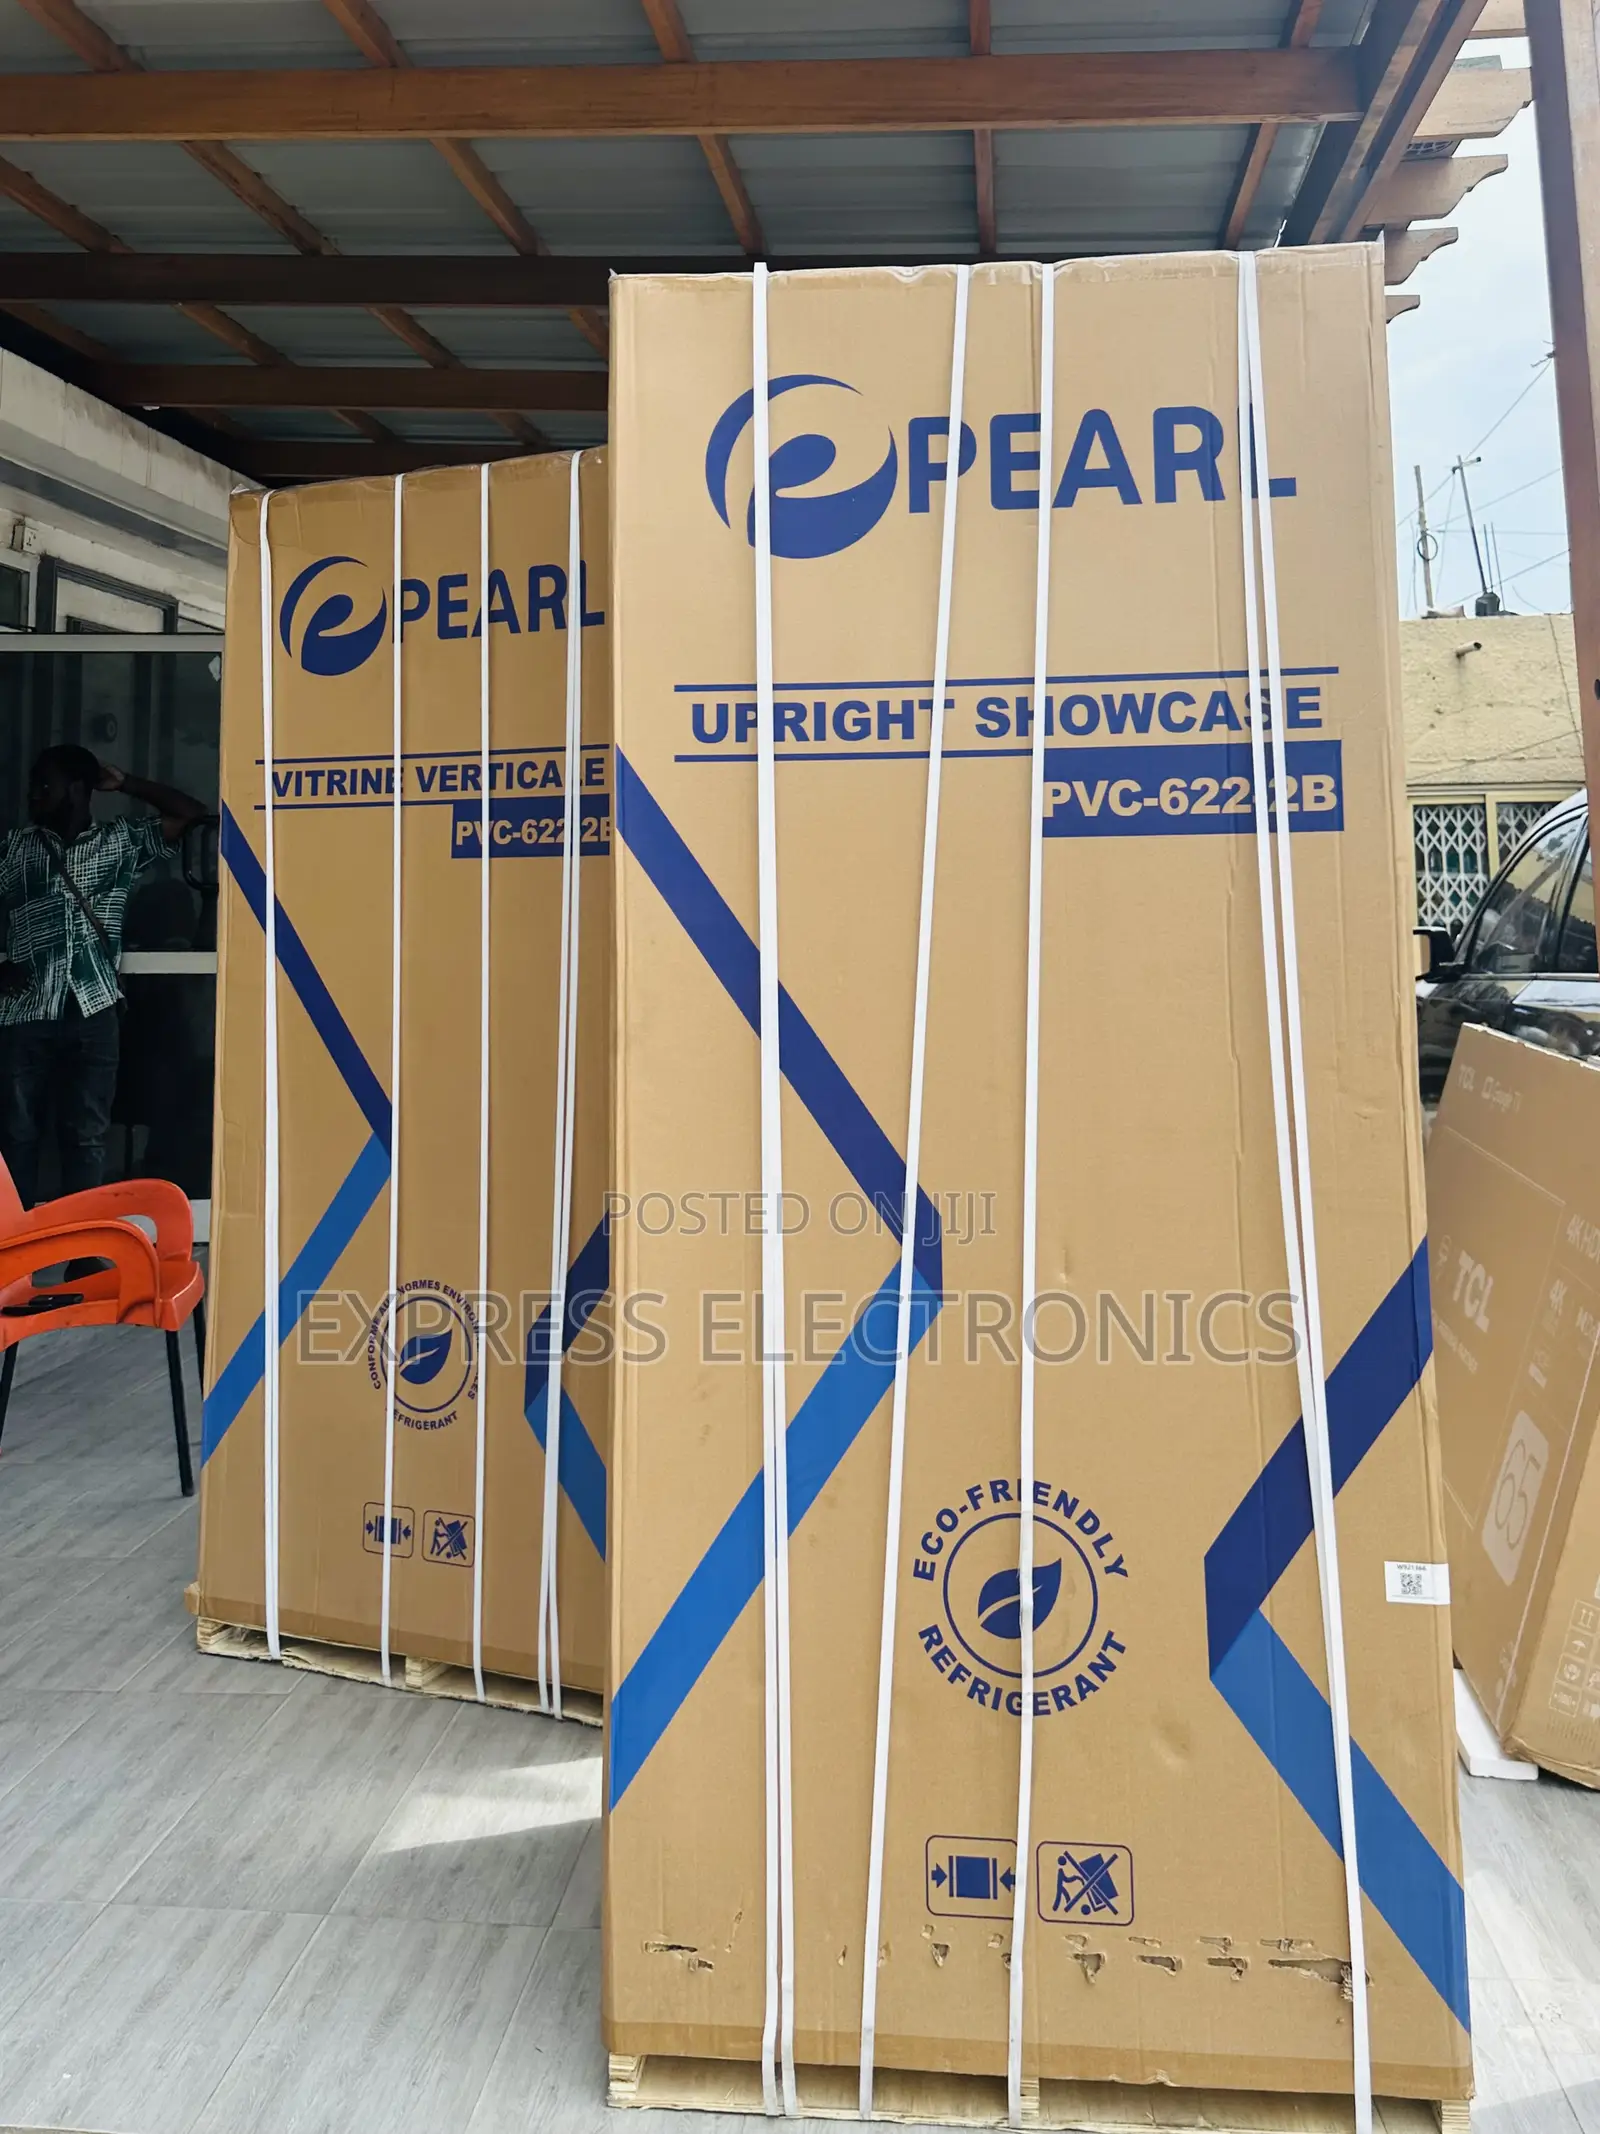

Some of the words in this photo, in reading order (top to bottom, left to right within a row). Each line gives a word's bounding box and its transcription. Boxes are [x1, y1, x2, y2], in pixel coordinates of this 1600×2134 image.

[908, 405, 1297, 514] PEARL
[393, 559, 605, 644] PEARL
[692, 699, 955, 744] UPRIGHT
[975, 686, 1323, 738] SHOWCASE
[271, 768, 404, 797] VITRINE
[415, 757, 605, 793] VERTICAE
[1453, 1250, 1495, 1333] TCL
[385, 1406, 458, 1431] EFRIGERANT
[918, 1623, 1127, 1717] REFRIGERANT
